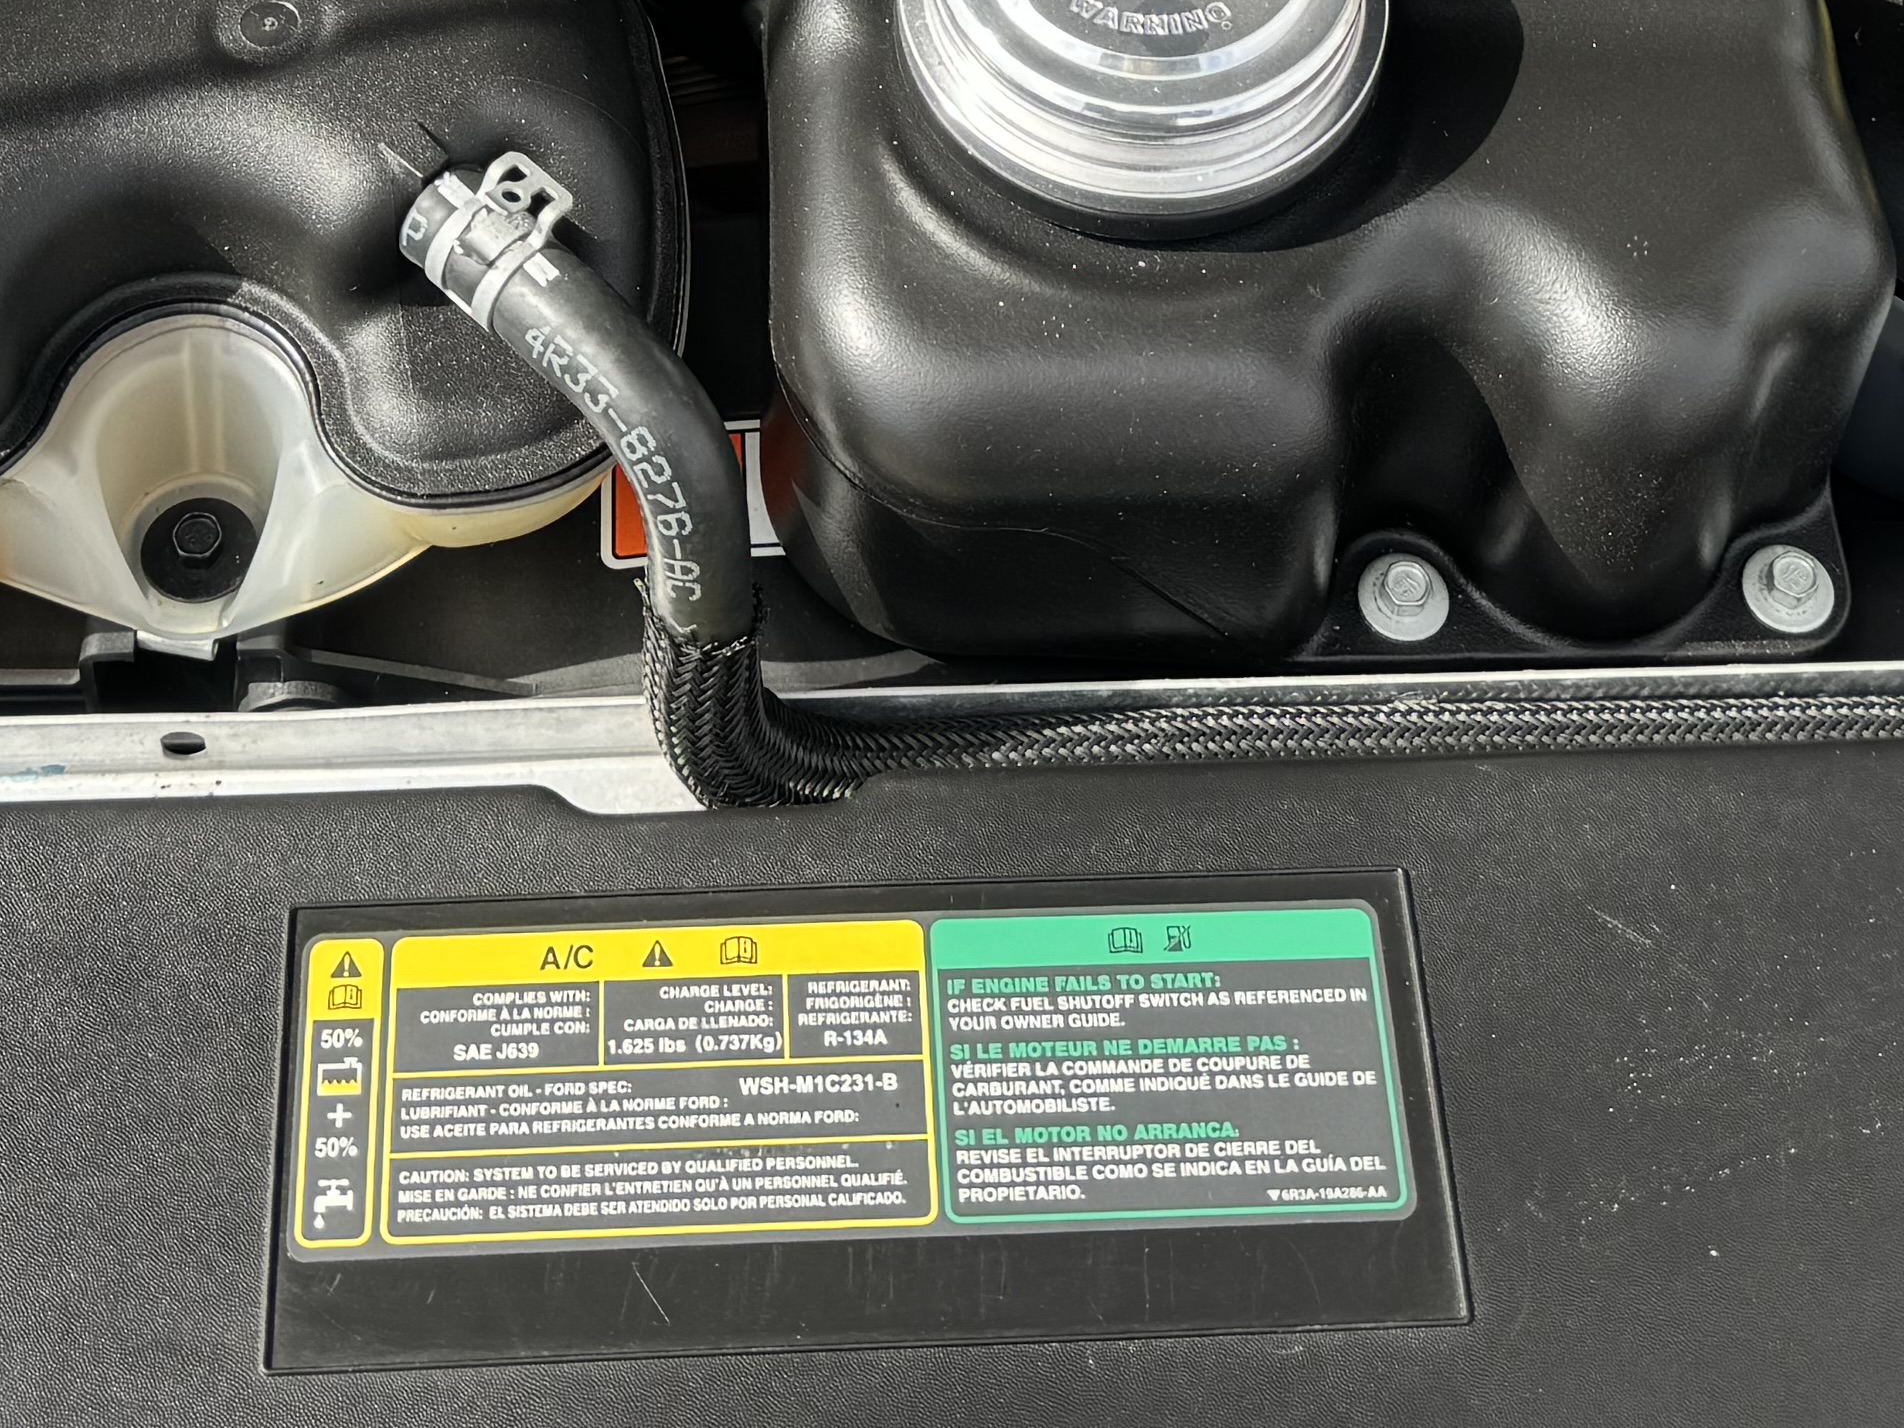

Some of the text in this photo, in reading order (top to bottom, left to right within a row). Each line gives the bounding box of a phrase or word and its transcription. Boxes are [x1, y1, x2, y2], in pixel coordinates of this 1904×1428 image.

[539, 943, 594, 971] A/C
[659, 983, 773, 1002] CHARGE LEVEL:
[807, 978, 911, 996] REFRIGERANT:
[947, 972, 1221, 995] IF ENGINE FAILS TO START:
[472, 989, 591, 1009] COMPLIES WITH:
[704, 998, 765, 1016] CHARGE
[947, 987, 1368, 1014] CHECK FUEL SHUTOFF SWITCH AS REFERENCED IN
[490, 1020, 590, 1037] CUMPLE CON:
[623, 1014, 774, 1032] CARGA DE LLENADO:
[798, 1009, 913, 1026] REFRIGERANTE:
[948, 1012, 1126, 1032] YOUR OWNER GUIDE.
[320, 1027, 363, 1050] 50%
[607, 1030, 784, 1055] 1.625 lbs (0.737Kg)
[824, 1028, 888, 1047] R-134A
[950, 1035, 1287, 1062] SI LE MOTEUR NE DEMARRE PAS
[453, 1042, 540, 1062] SAE J639
[950, 1054, 1311, 1079] VÉRIFIER LA COMMANDE DE COUPURE DE
[401, 1080, 632, 1102] REFRIGERANT OIL FORD SPEC:
[738, 1072, 898, 1096] WSH-M1C231-B
[952, 1070, 1377, 1098] CARBURANT, COMME INDIQUÉ DANS LE GUIDE DE
[400, 1095, 720, 1121] LUBRIFIANT CONFORME À LA NORME FORD
[953, 1096, 1116, 1116] L'AUTOMOBILISTE.
[400, 1109, 859, 1140] USE ACEITE PARA REFRIGERANTES CONFORME A NORMA FORD:
[955, 1121, 1240, 1146] SI EL MOTOR NO ARRANCA:
[314, 1136, 359, 1158] 50%
[956, 1139, 1322, 1165] REVISE EL INTERRUPTOR DE CIERRE DEL
[398, 1169, 469, 1185] CAUTION:
[473, 1166, 534, 1182] SYSTEM
[537, 1165, 557, 1180] TO
[560, 1164, 581, 1179] BE
[585, 1161, 659, 1178] SERVICED
[661, 1160, 681, 1175] BY
[685, 1157, 763, 1177] QUALIFIED
[957, 1154, 1387, 1185] COMBUSTIBLE COMO SE INDICA EN LA GUÍA DEL
[398, 1189, 432, 1204] MISE
[435, 1188, 455, 1203] EN
[457, 1186, 507, 1202] GARDE
[518, 1185, 537, 1199] NE
[540, 1182, 601, 1199] CONFIER
[604, 1179, 692, 1196] L'ENTRETIEN
[732, 1177, 752, 1191] UN
[755, 1174, 838, 1190] PERSONNEL
[958, 1184, 1086, 1203] PROPIETARIO.
